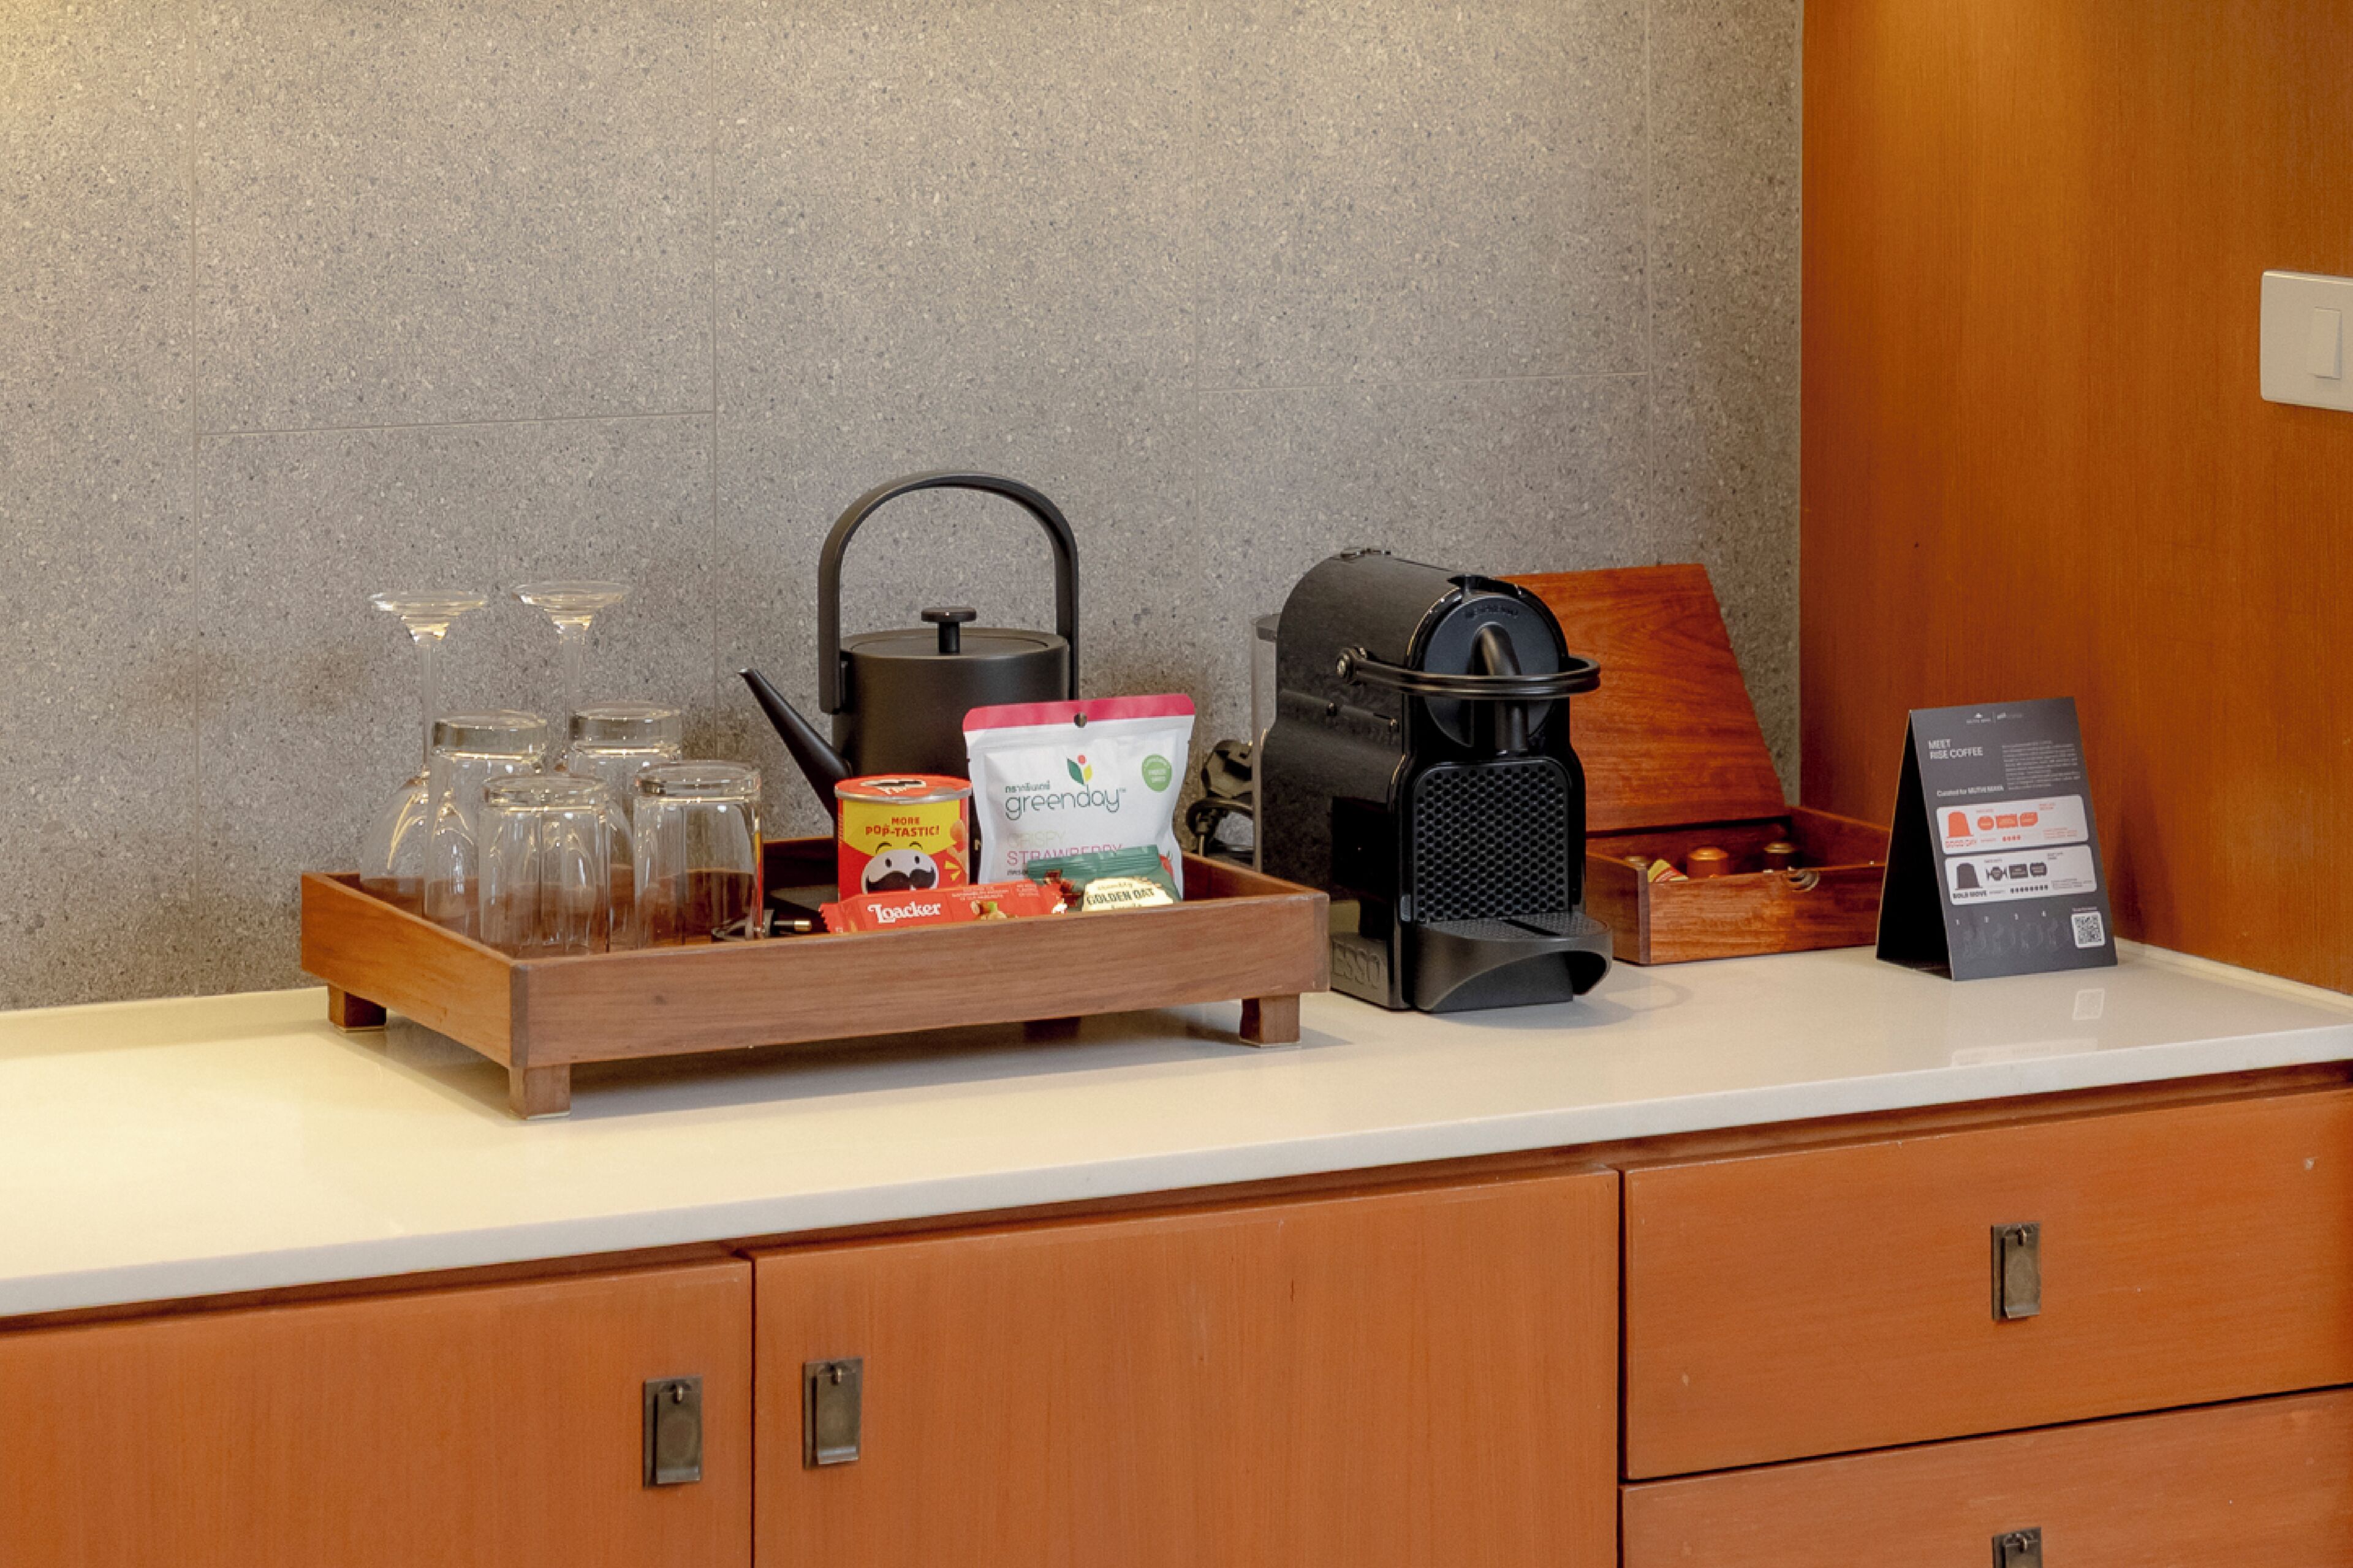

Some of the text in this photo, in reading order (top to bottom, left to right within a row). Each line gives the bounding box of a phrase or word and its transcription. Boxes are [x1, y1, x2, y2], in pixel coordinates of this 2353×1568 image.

[1930, 746, 1984, 759] RISE COFFEE
[891, 816, 920, 825] MORE
[865, 825, 940, 837] POP-TASTIC!
[1086, 887, 1154, 905] GOLDEN OAT
[867, 901, 941, 923] Loacker
